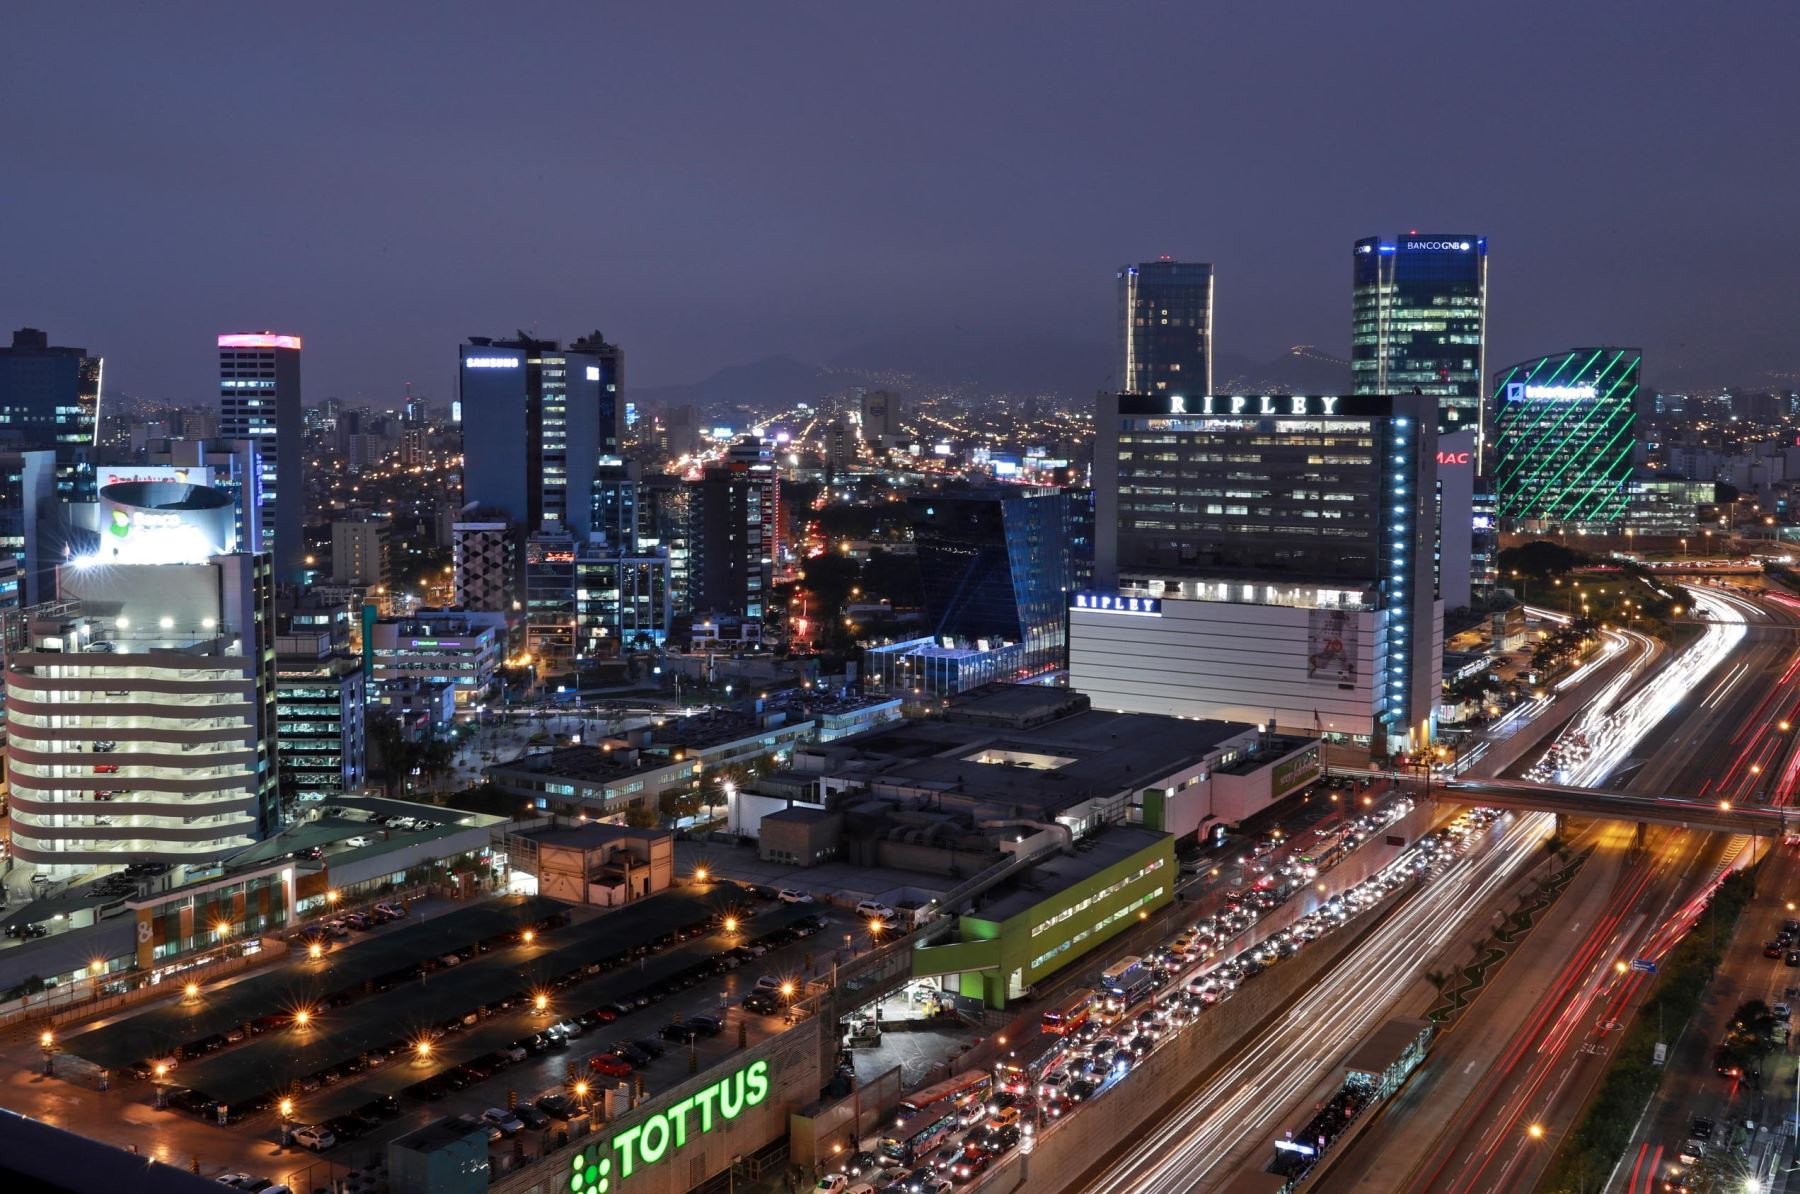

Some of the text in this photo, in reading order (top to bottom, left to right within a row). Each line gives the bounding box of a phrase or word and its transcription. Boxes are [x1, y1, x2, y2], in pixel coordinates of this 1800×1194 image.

[466, 357, 519, 368] SAMSUNG
[1170, 396, 1338, 414] RIPLEY
[1077, 595, 1154, 612] RIPLEY
[613, 1060, 769, 1179] TOTTUS
